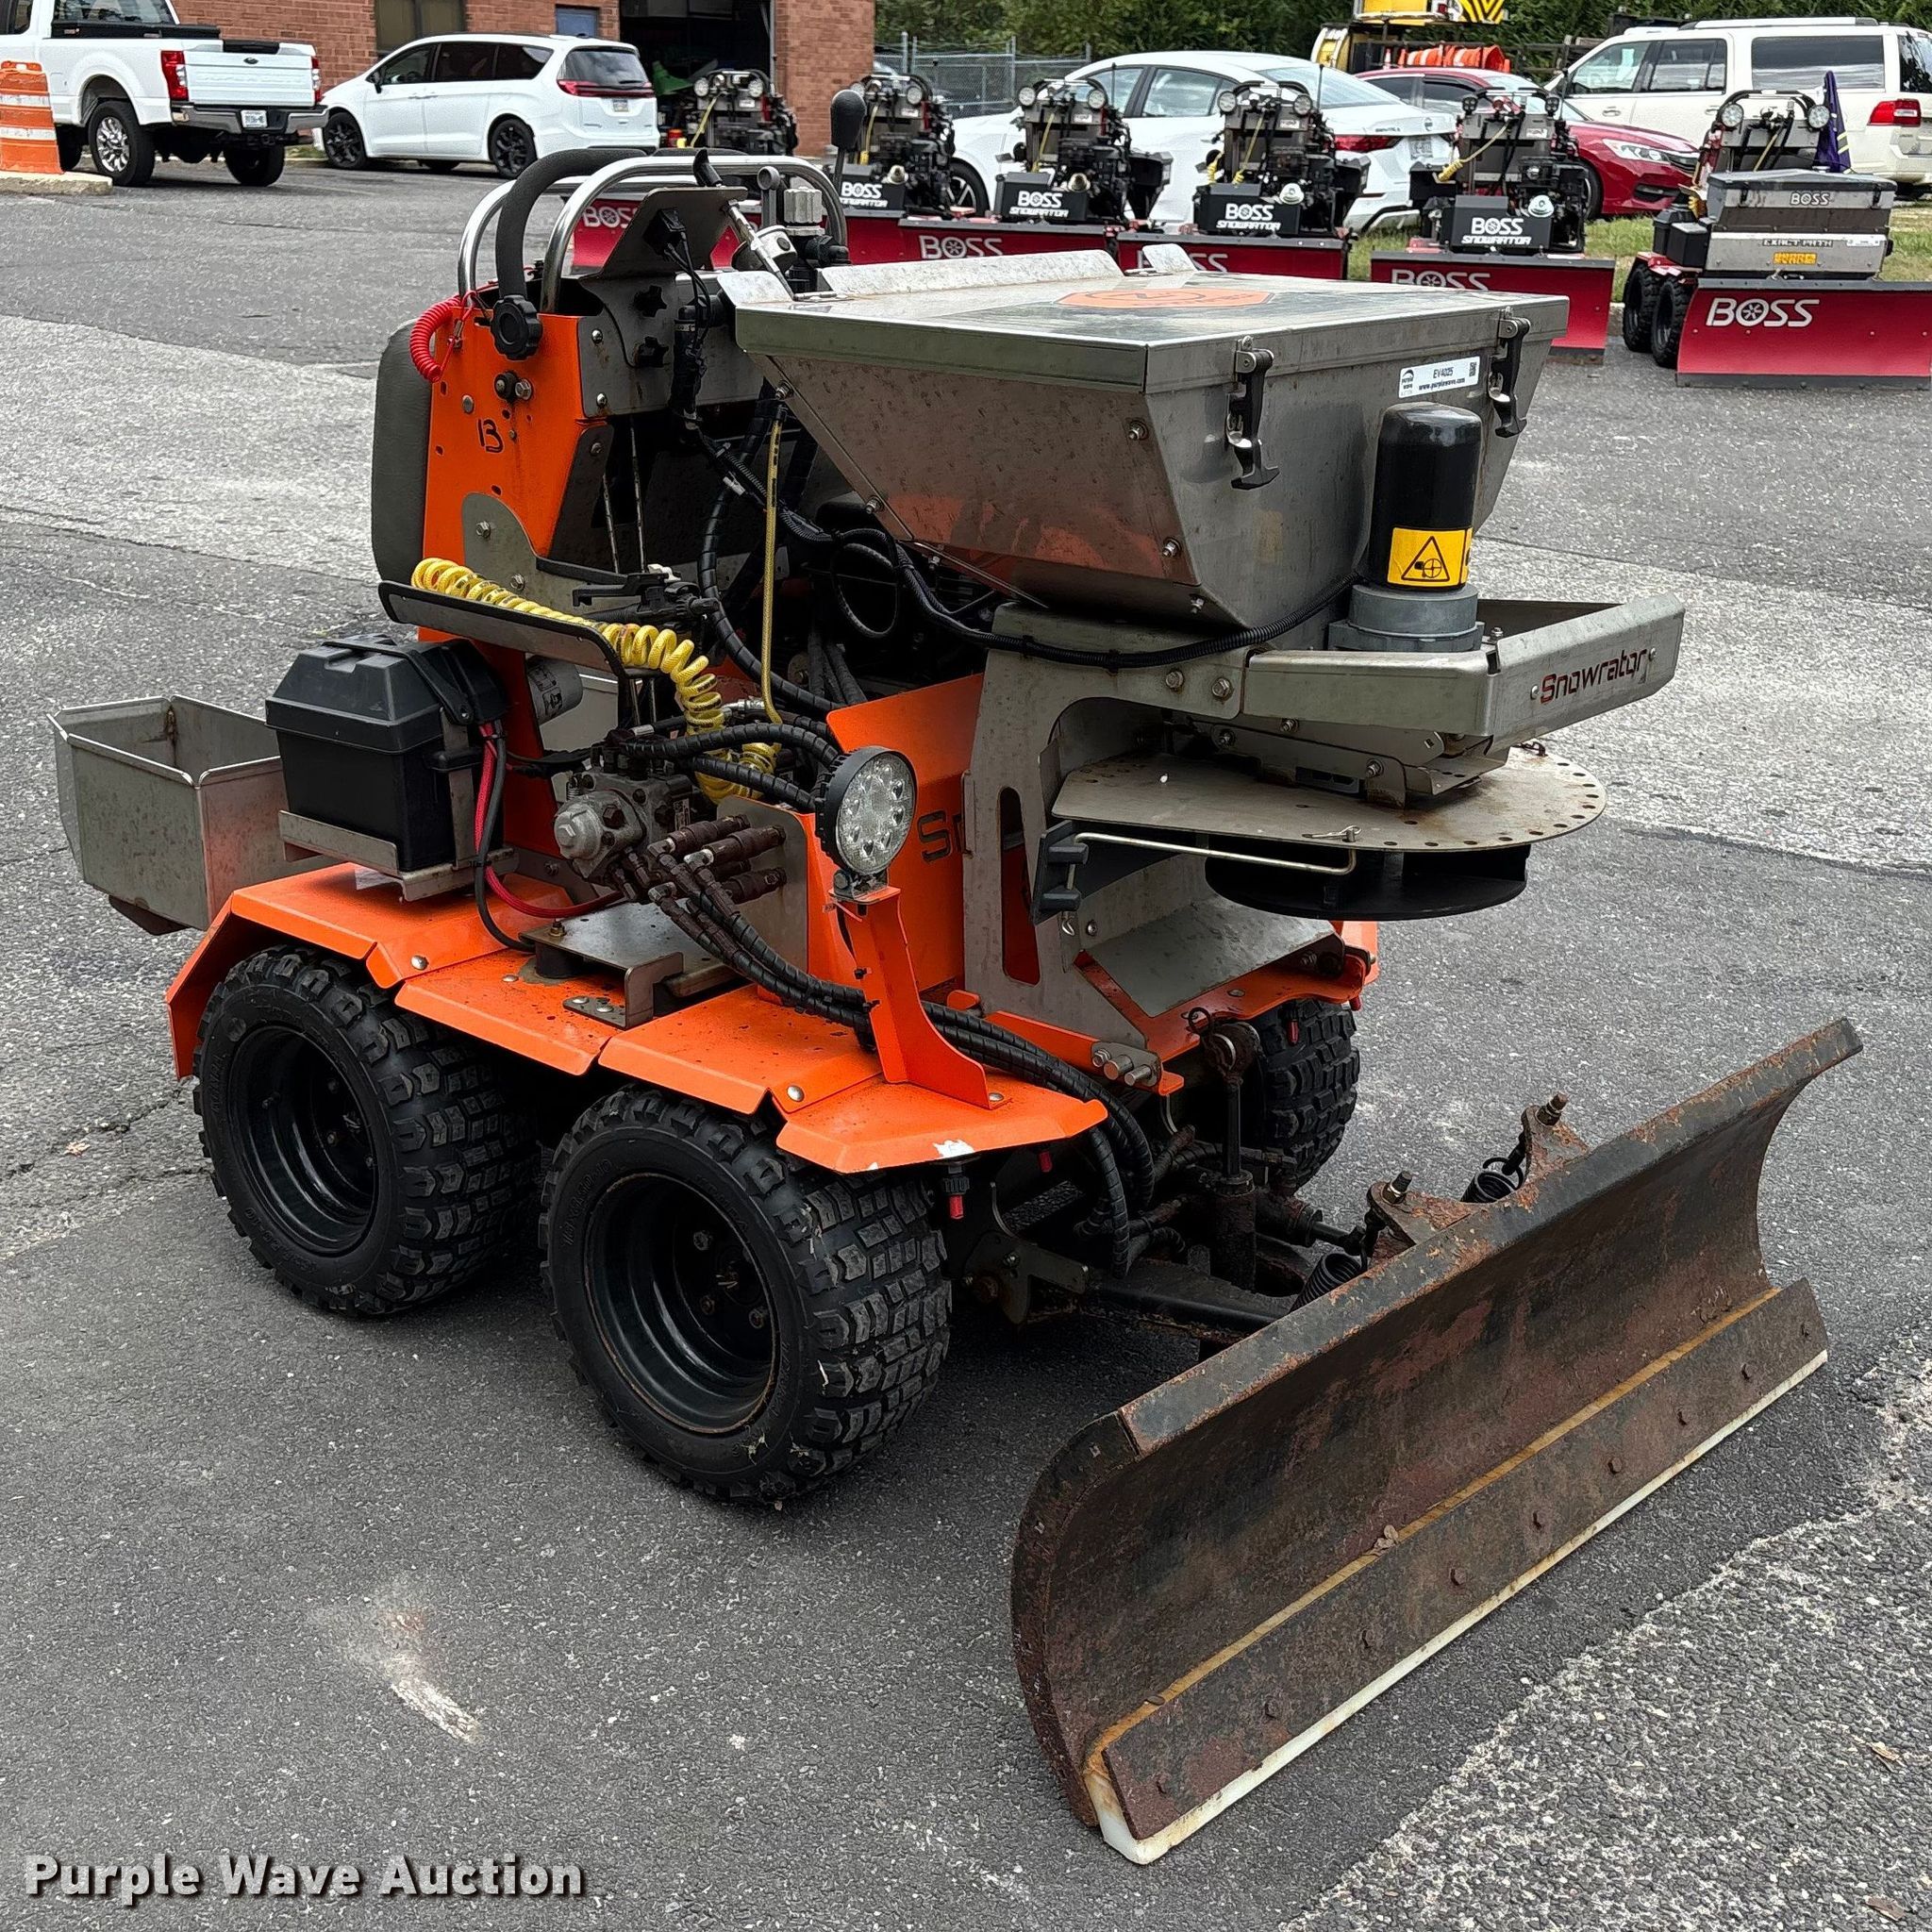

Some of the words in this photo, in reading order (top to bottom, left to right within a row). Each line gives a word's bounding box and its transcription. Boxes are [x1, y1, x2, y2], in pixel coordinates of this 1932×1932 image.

[841, 181, 883, 199] BOSS
[1790, 192, 1831, 206] BOSS
[1017, 191, 1063, 208] BOSS
[583, 206, 639, 228] BOS
[1225, 203, 1274, 221] BOSS
[1471, 217, 1524, 235] BOSS
[919, 235, 1004, 259] BOSS
[1802, 239, 1834, 247] PATH
[1391, 269, 1491, 292] BOSS
[1706, 297, 1821, 327] BOSS
[1540, 649, 1648, 705] Snowrator
